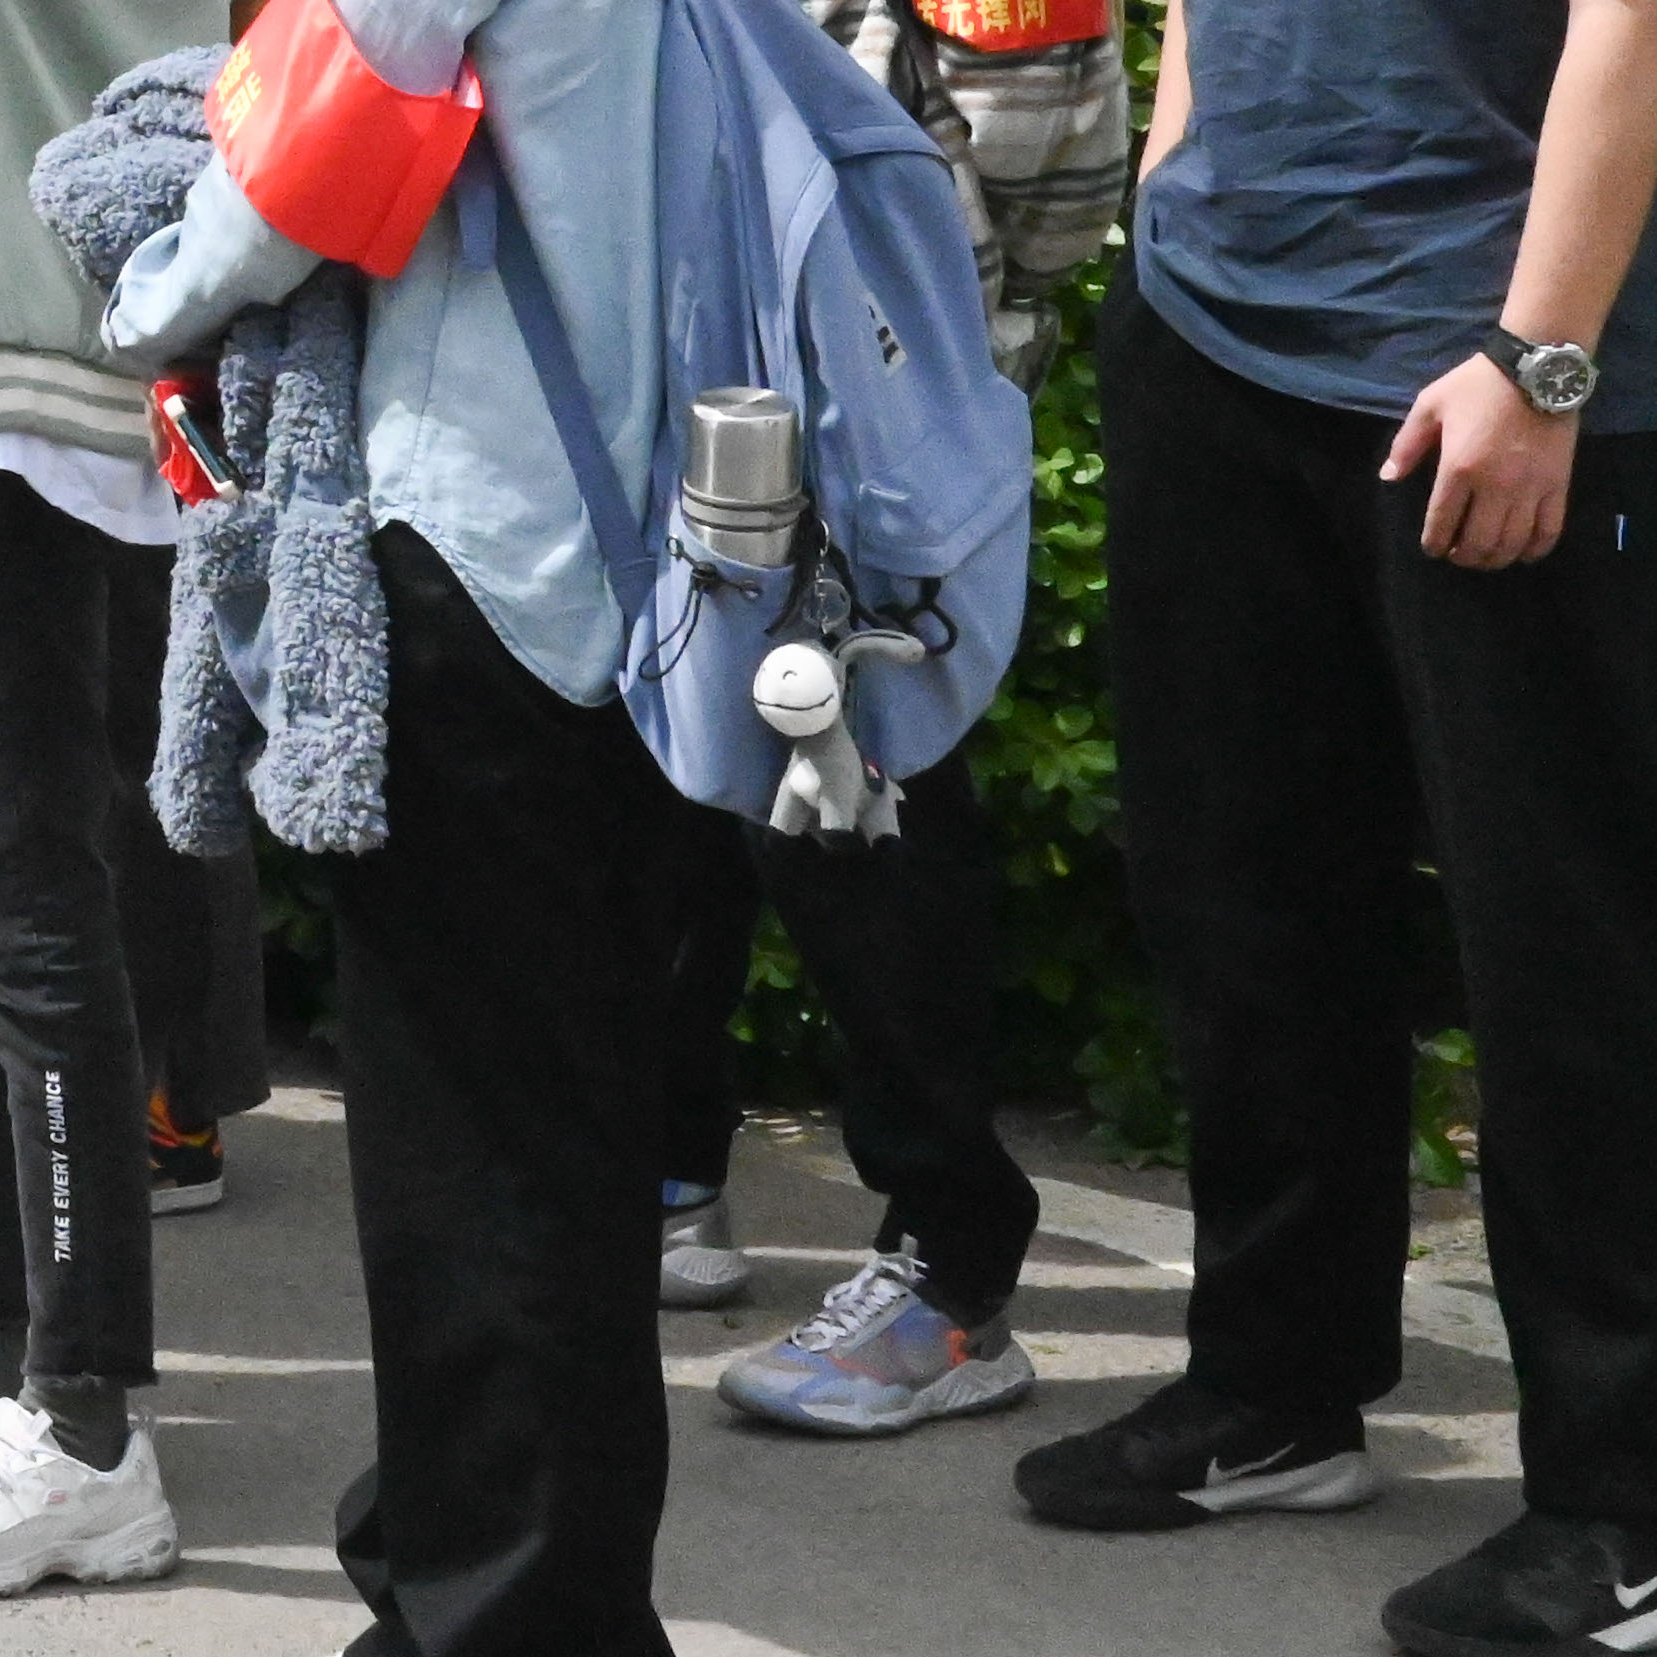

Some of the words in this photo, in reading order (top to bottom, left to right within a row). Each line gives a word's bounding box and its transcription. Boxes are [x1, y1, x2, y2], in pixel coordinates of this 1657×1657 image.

[45, 1070, 68, 1144] CHANCE
[51, 1150, 71, 1210] EVERY
[53, 1215, 73, 1263] TAKE
